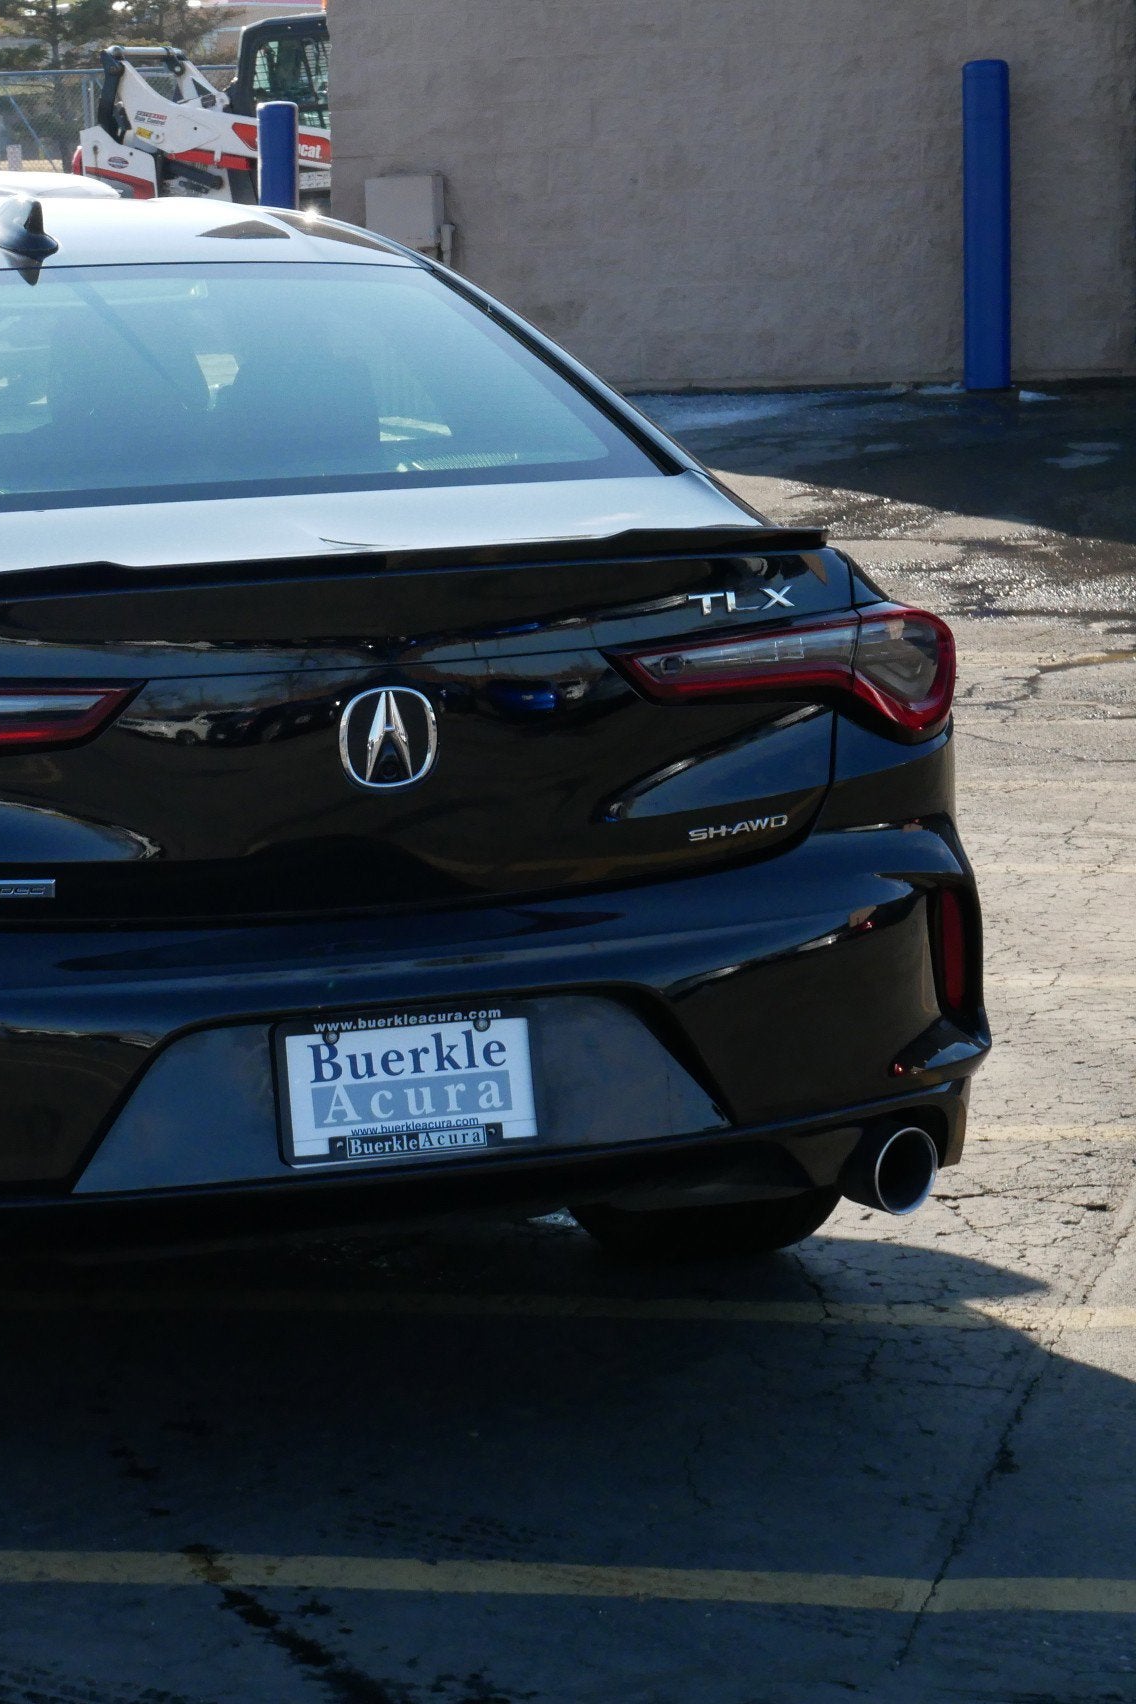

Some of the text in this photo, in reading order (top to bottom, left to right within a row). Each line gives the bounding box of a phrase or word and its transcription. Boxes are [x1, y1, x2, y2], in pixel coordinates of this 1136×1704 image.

[687, 585, 795, 616] TLX
[688, 814, 788, 842] SH-AWD
[313, 1008, 502, 1033] www.buerkleacura.com
[307, 1028, 507, 1084] Buerkle
[323, 1080, 504, 1124] Acura
[350, 1116, 479, 1137] www.buerkleacura.com
[349, 1127, 482, 1156] Buerkle Acura
